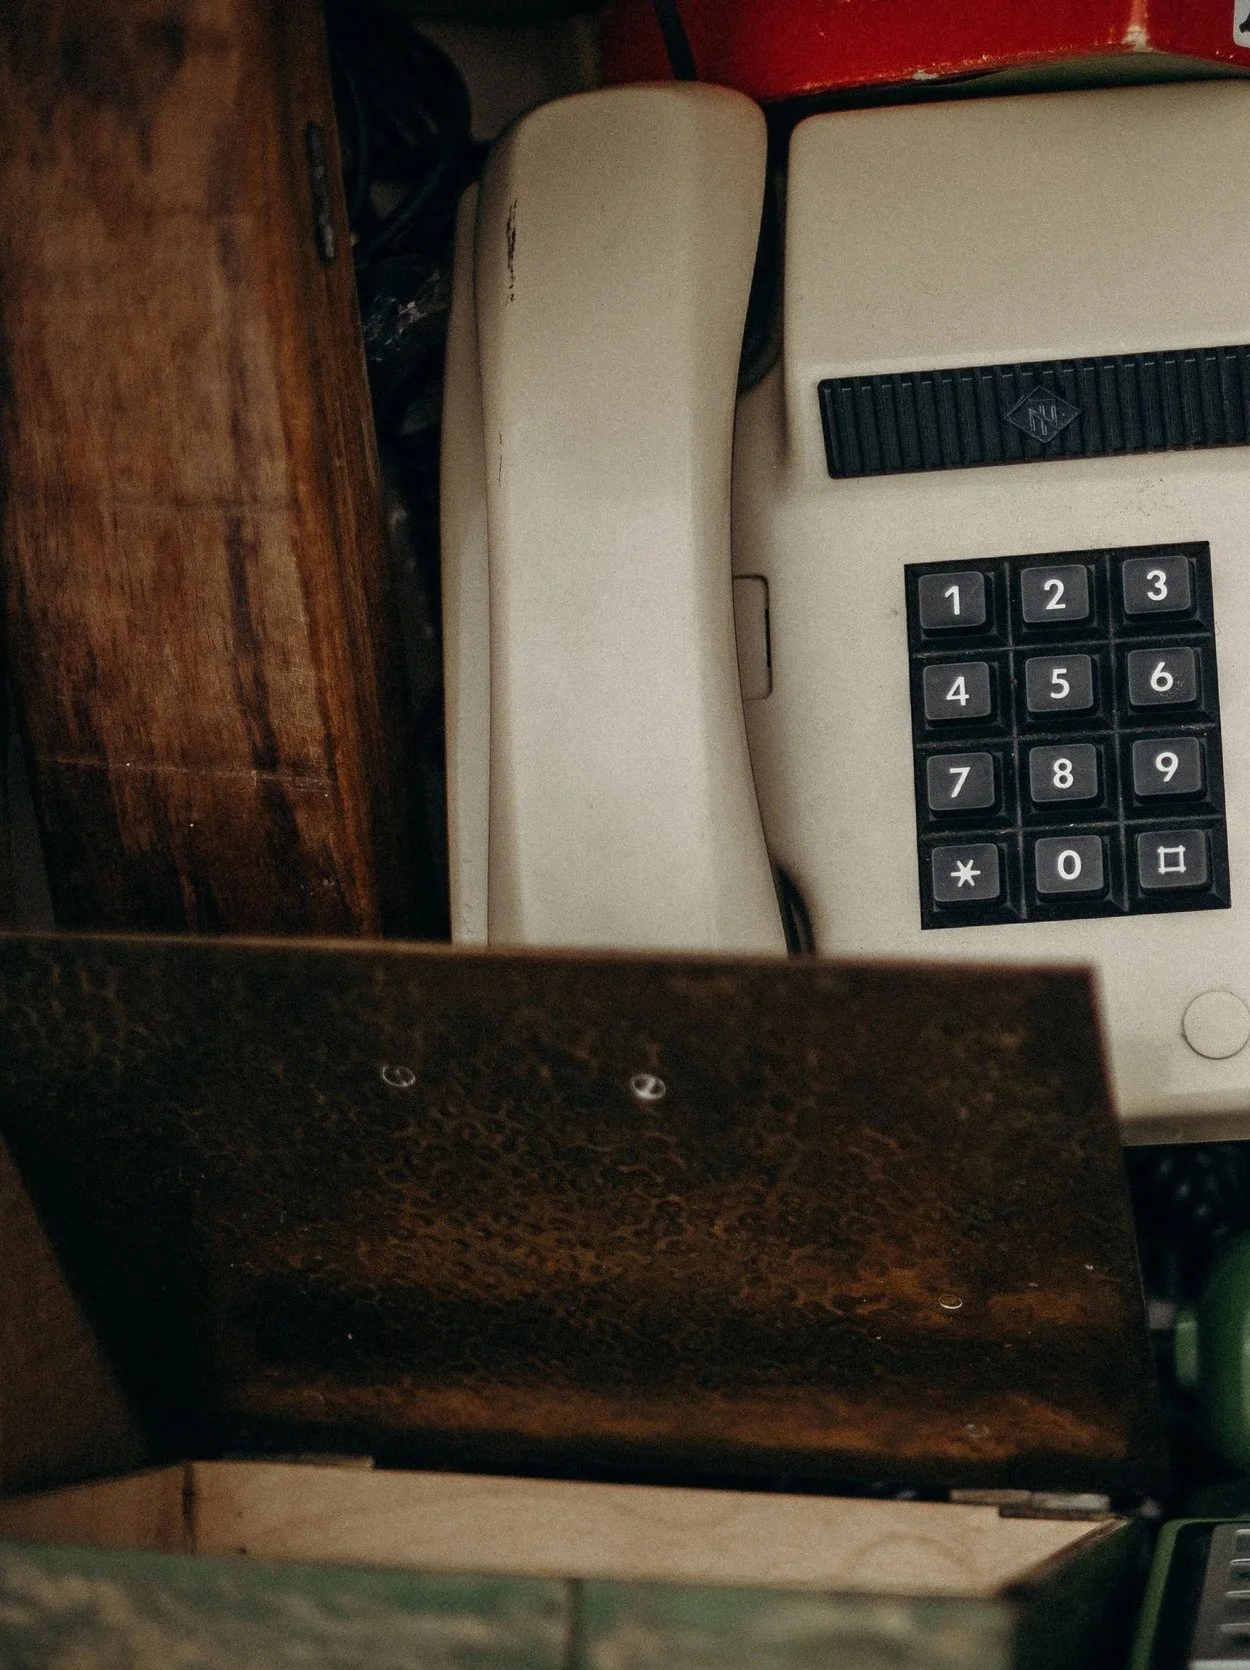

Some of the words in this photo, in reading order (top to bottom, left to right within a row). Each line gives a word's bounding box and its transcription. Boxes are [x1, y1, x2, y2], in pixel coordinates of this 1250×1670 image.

[944, 586, 961, 616] 1
[1043, 579, 1066, 610] 2
[1146, 570, 1168, 600] 3
[946, 677, 970, 706] 4
[1050, 669, 1070, 699] 5
[1150, 662, 1173, 692] 6
[949, 768, 971, 798] 7
[1052, 758, 1074, 789] 8
[1155, 752, 1179, 782] 9
[1057, 850, 1082, 880] 0
